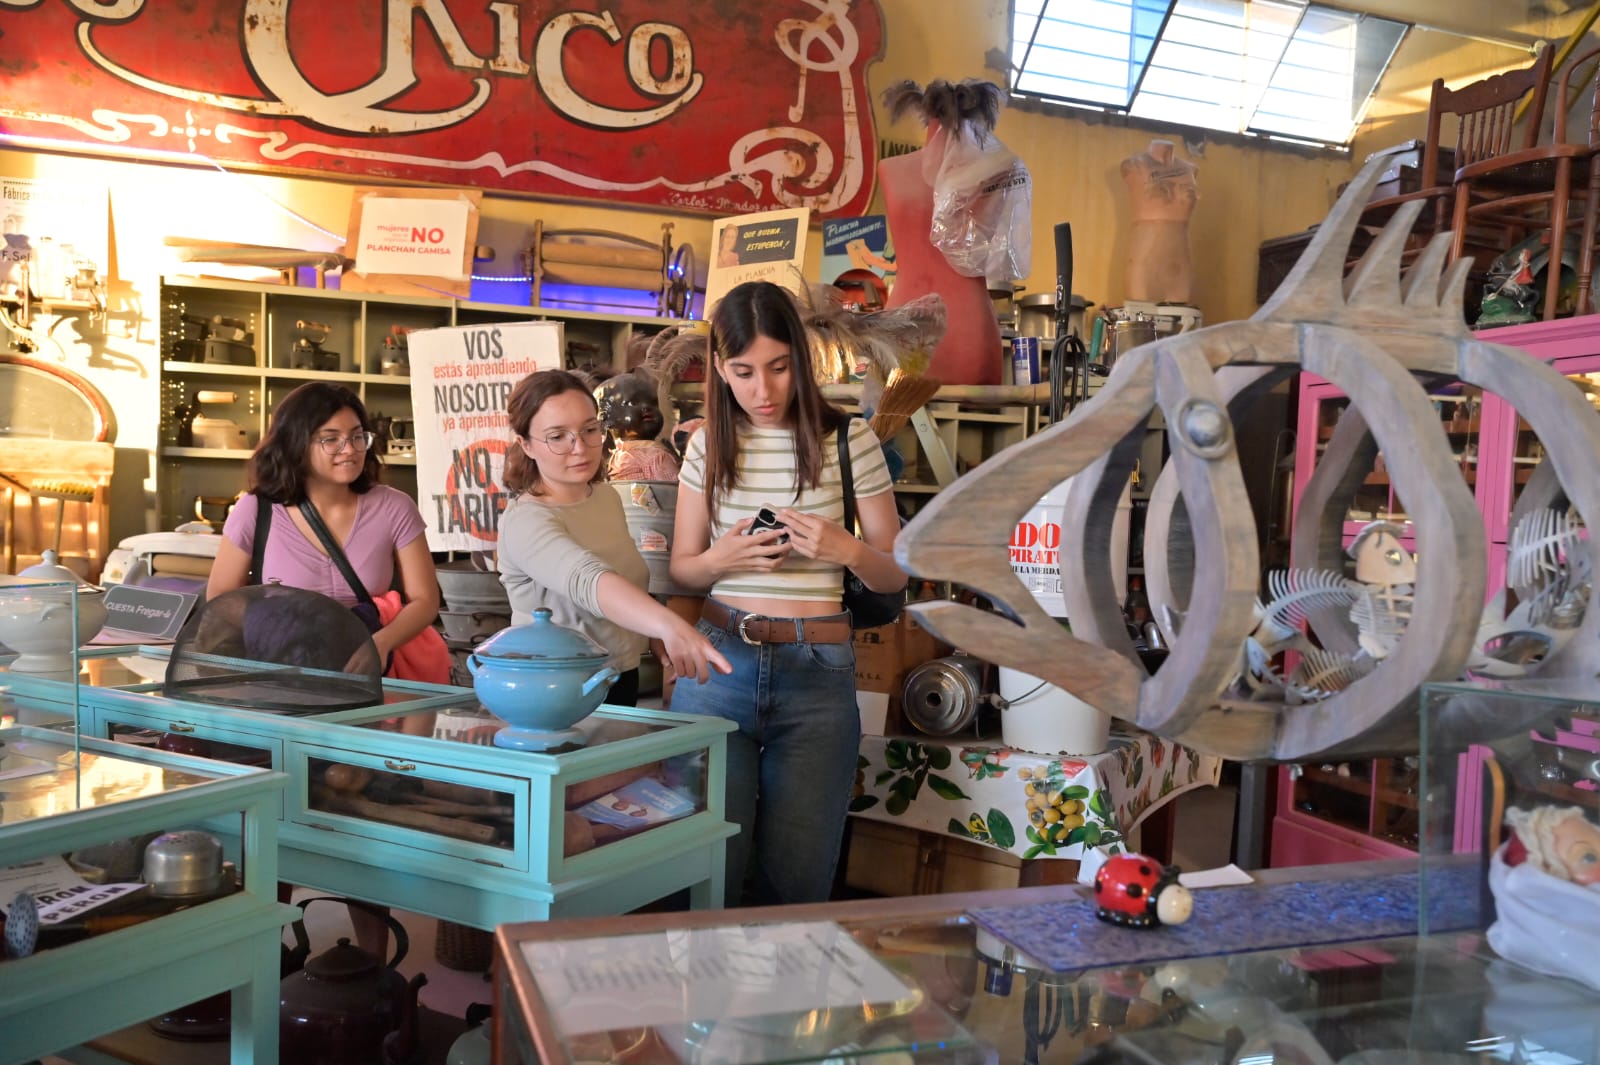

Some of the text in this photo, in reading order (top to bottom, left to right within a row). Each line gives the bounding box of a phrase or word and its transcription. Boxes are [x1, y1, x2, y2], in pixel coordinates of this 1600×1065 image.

[411, 227, 445, 244] NO
[366, 244, 451, 255] PLANCHAN CAMISA
[463, 329, 503, 361] VOS
[433, 357, 538, 379] estás aprendiendo
[433, 381, 513, 415] NOSOTR
[442, 417, 456, 433] ya
[451, 447, 492, 490] NO
[431, 492, 516, 533] TARIF
